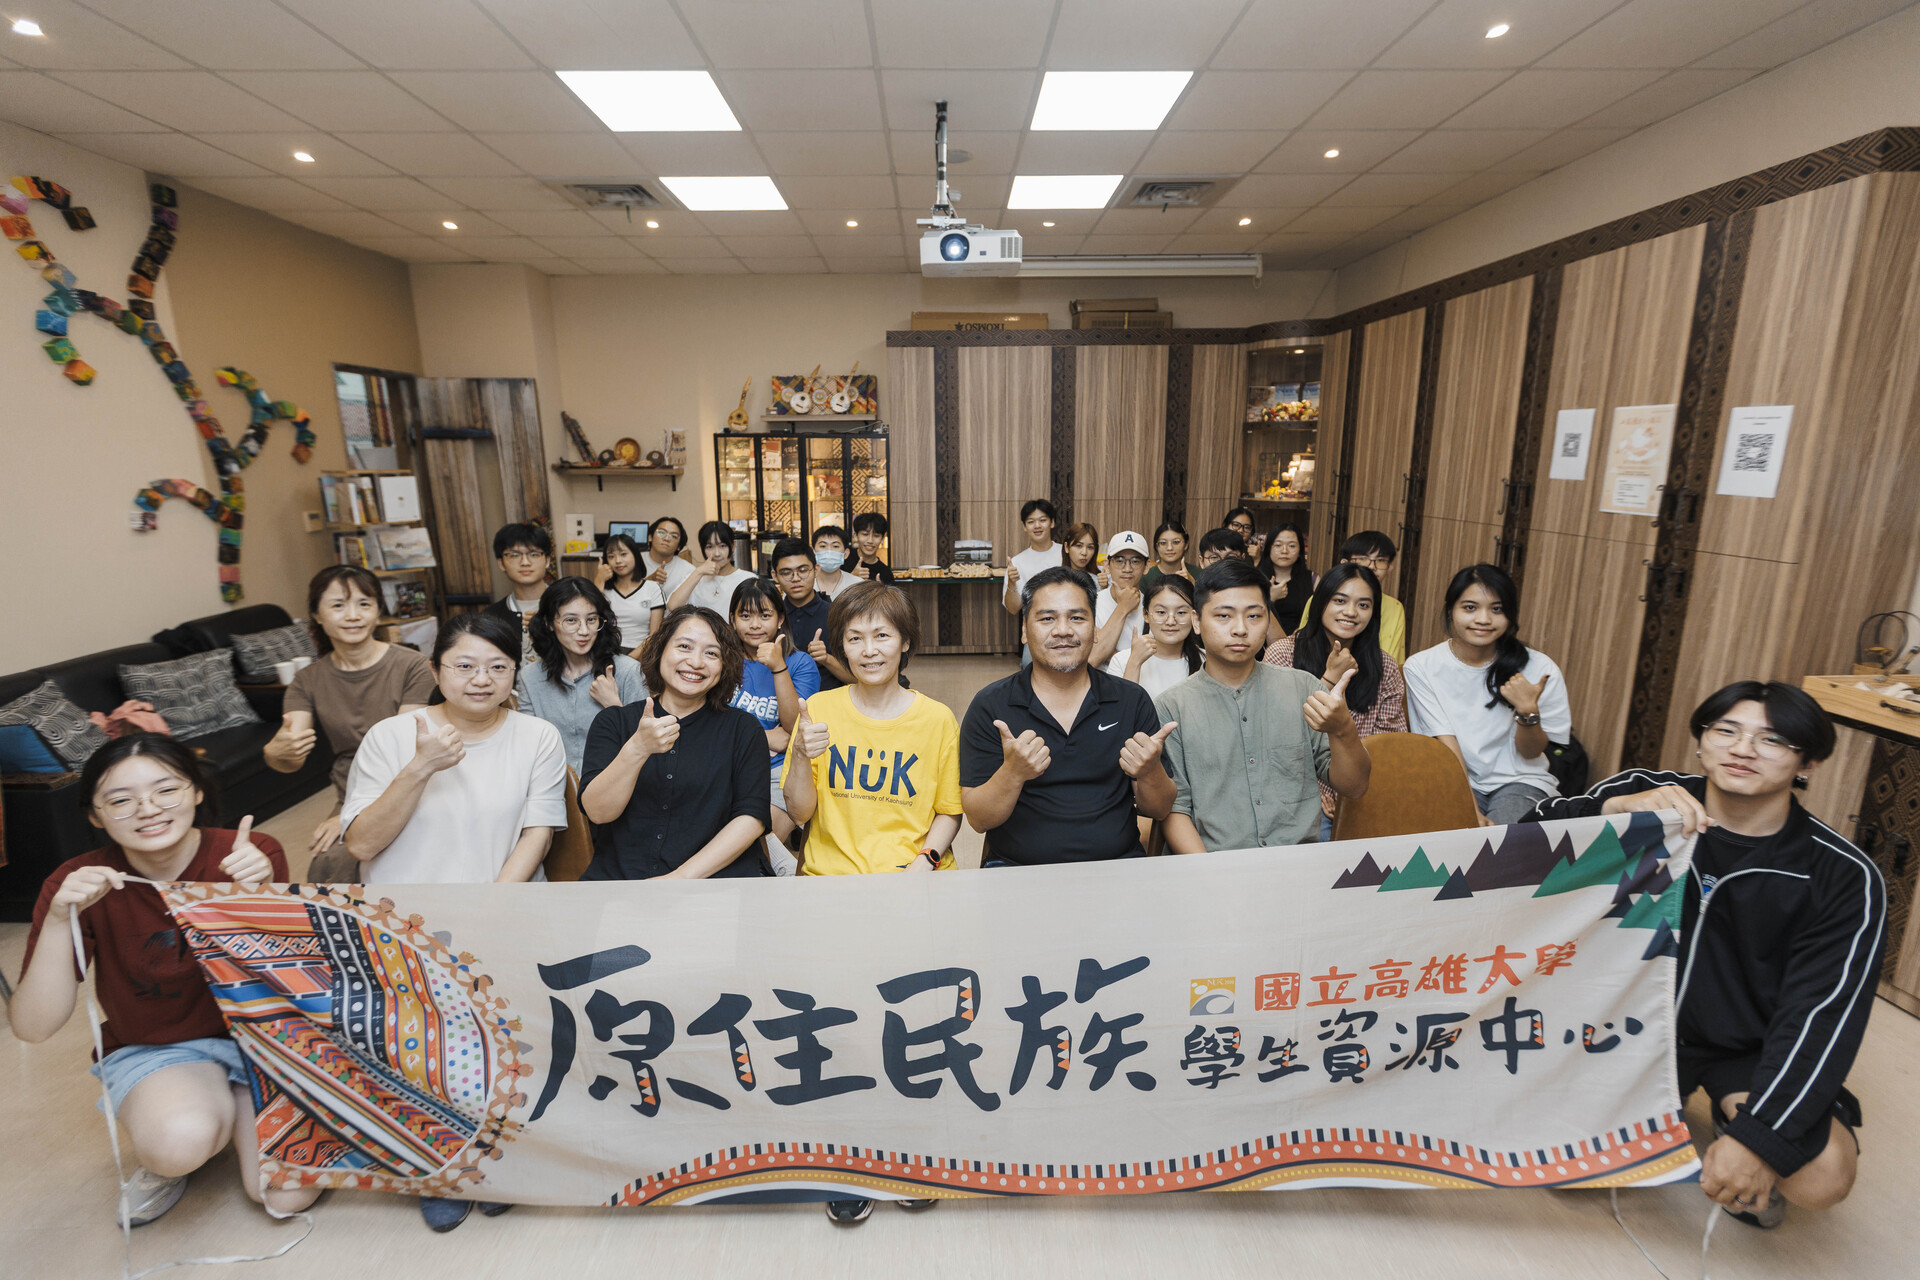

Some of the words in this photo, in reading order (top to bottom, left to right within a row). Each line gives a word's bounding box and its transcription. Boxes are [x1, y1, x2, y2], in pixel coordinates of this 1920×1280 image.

[1124, 534, 1134, 543] A
[850, 793, 877, 801] University
[1254, 938, 1580, 1012] 國立高雄大學
[528, 944, 1157, 1122] 原住民族
[1179, 996, 1644, 1090] 學生資源中心
